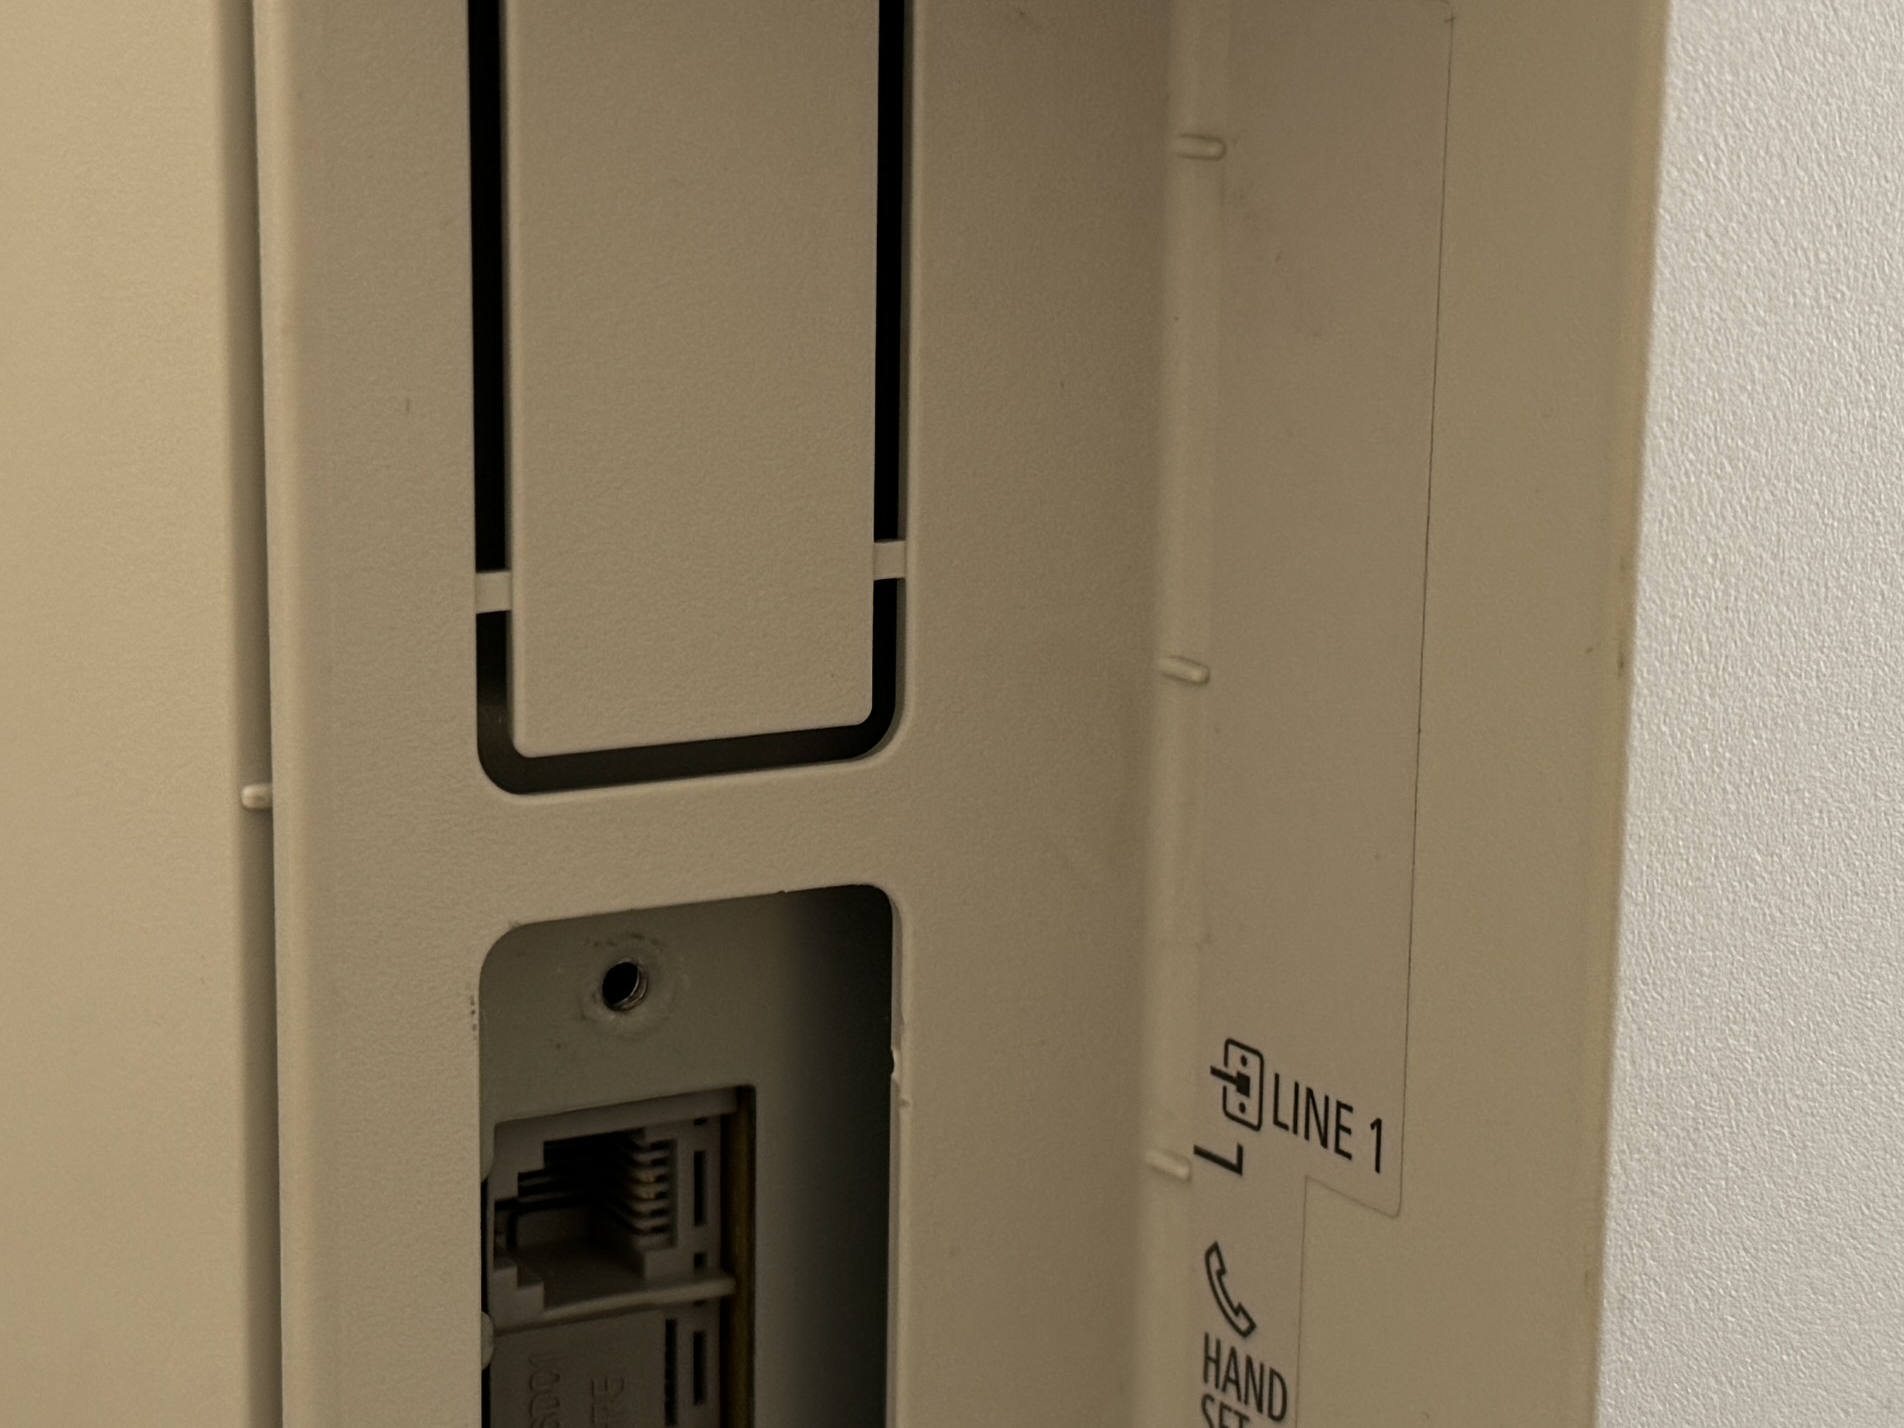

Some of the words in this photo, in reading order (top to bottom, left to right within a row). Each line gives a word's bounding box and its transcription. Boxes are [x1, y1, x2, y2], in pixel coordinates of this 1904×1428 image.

[1273, 1071, 1354, 1161] LINE
[1369, 1117, 1383, 1174] 1
[1202, 1331, 1288, 1422] HAND
